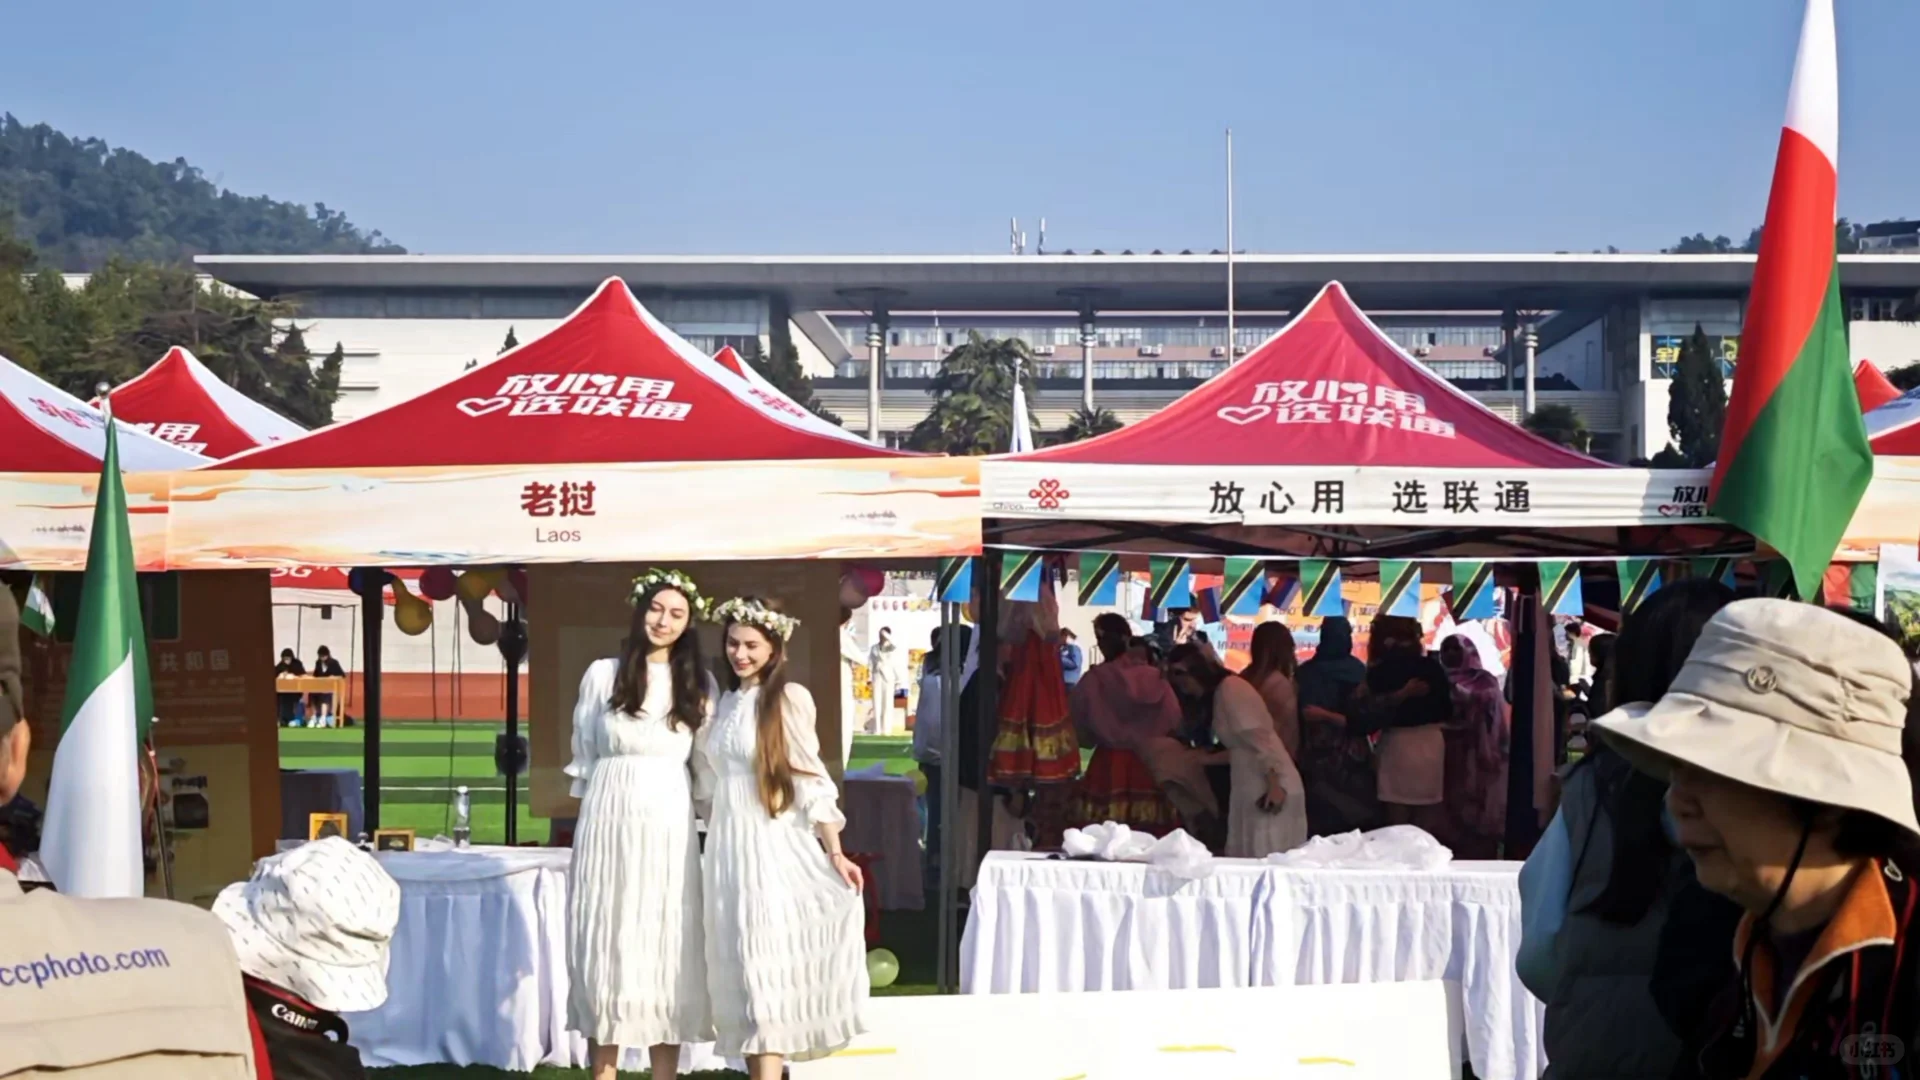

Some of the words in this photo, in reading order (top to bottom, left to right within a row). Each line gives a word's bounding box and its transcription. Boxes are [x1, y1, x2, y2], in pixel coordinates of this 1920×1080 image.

[495, 373, 675, 400] 放心用
[1250, 380, 1426, 414] 放心用
[508, 396, 693, 421] 选联通
[1275, 402, 1457, 439] 选联通
[520, 480, 597, 517] 老挝
[1208, 480, 1345, 514] 放心用
[1391, 479, 1531, 514] 选联通
[535, 526, 582, 543] Laos
